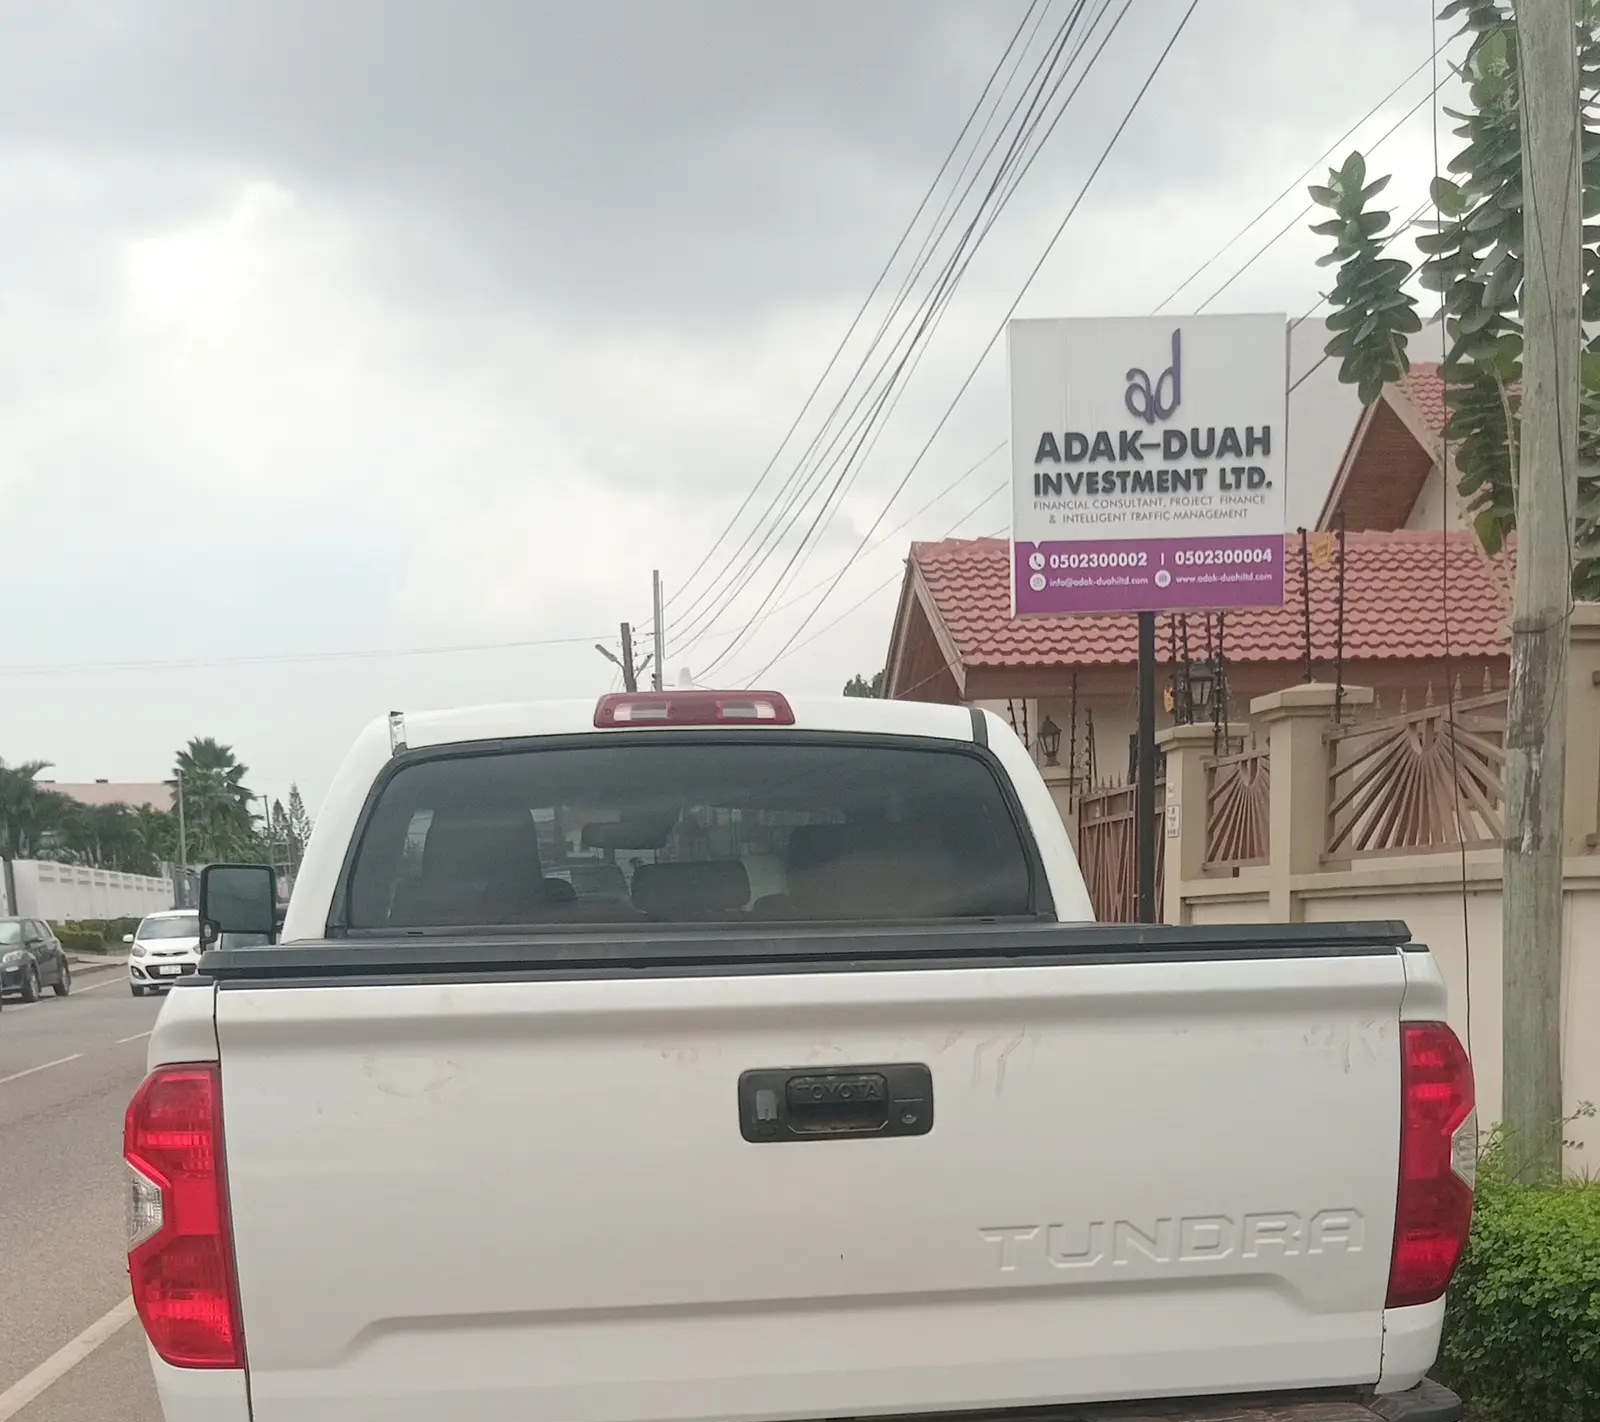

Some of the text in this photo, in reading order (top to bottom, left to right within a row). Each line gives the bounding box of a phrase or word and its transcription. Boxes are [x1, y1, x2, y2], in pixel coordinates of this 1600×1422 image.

[1034, 425, 1271, 464] ADAK-DUAH
[1033, 466, 1273, 496] INVESTMENT LTD.
[1033, 494, 1266, 511] FINANCIAL CONSULTANT, PROJECT FINANCE
[1049, 508, 1248, 525] & INTELLIGENT TRAFFIC MANAGEMENT
[1049, 548, 1273, 569] 0502300002 0502300004
[796, 1082, 883, 1100] TOYOTA
[978, 1207, 1364, 1272] TUNDRA
